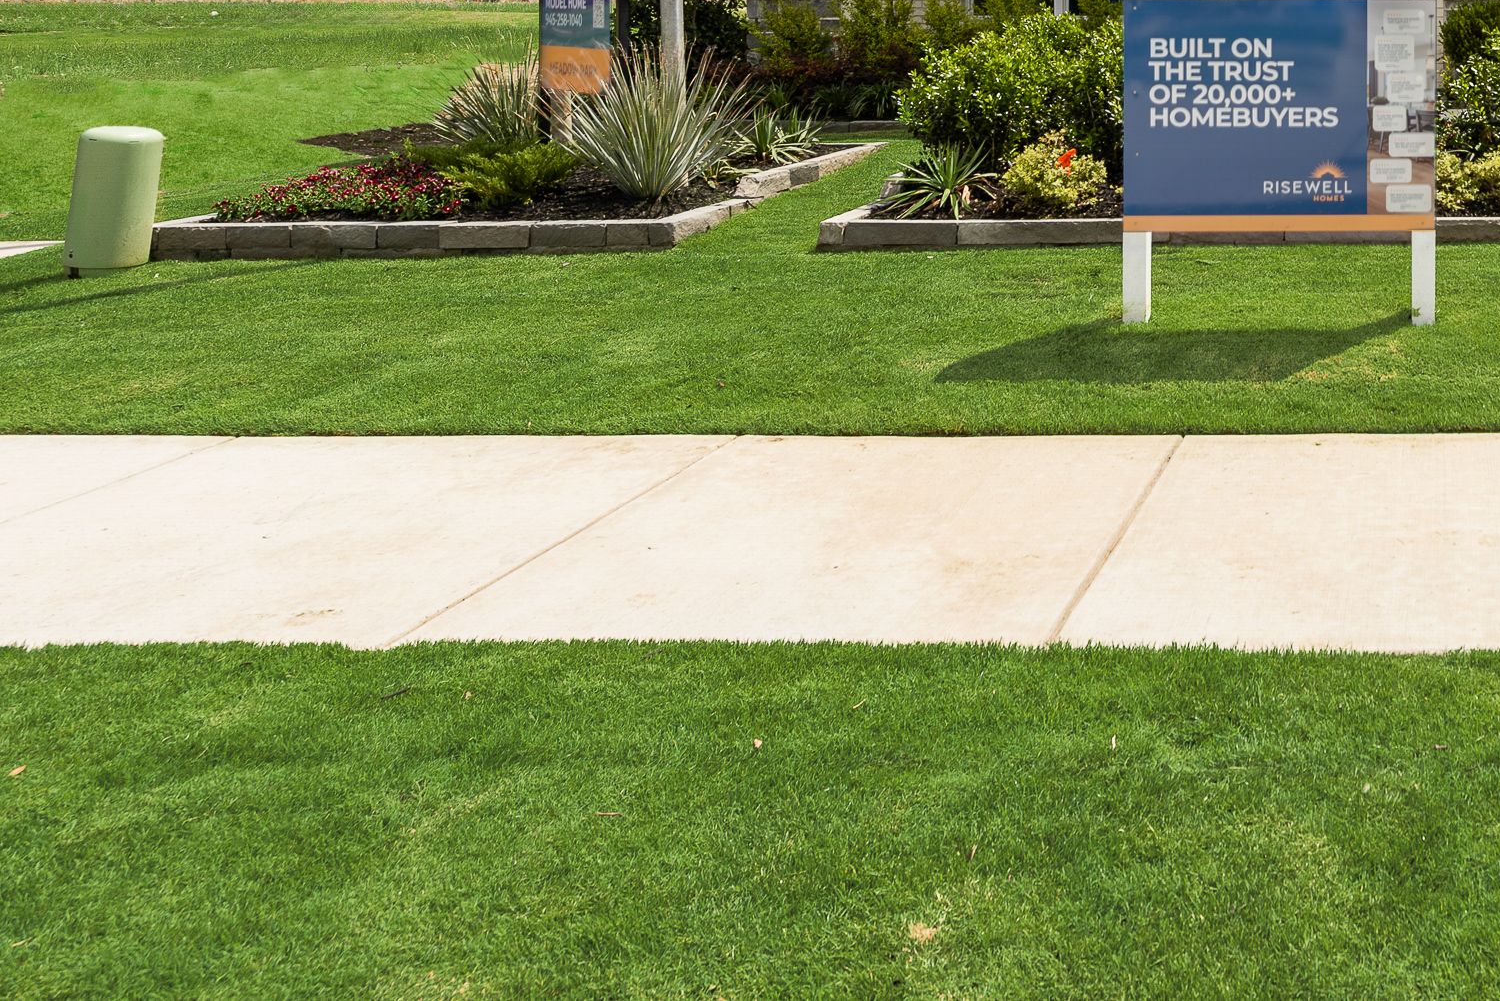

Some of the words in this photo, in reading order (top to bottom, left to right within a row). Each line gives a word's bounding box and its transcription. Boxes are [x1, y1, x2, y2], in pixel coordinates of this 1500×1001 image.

[1149, 37, 1226, 59] BUILT
[1230, 37, 1273, 59] ON
[1148, 60, 1202, 82] THE
[1207, 60, 1295, 82] TRUST
[1149, 83, 1187, 105] OF
[1192, 83, 1296, 108] 20,000+
[1149, 106, 1340, 128] HOMEBUYERS
[1263, 180, 1353, 195] RISEWELL
[1313, 194, 1345, 202] HOMES
